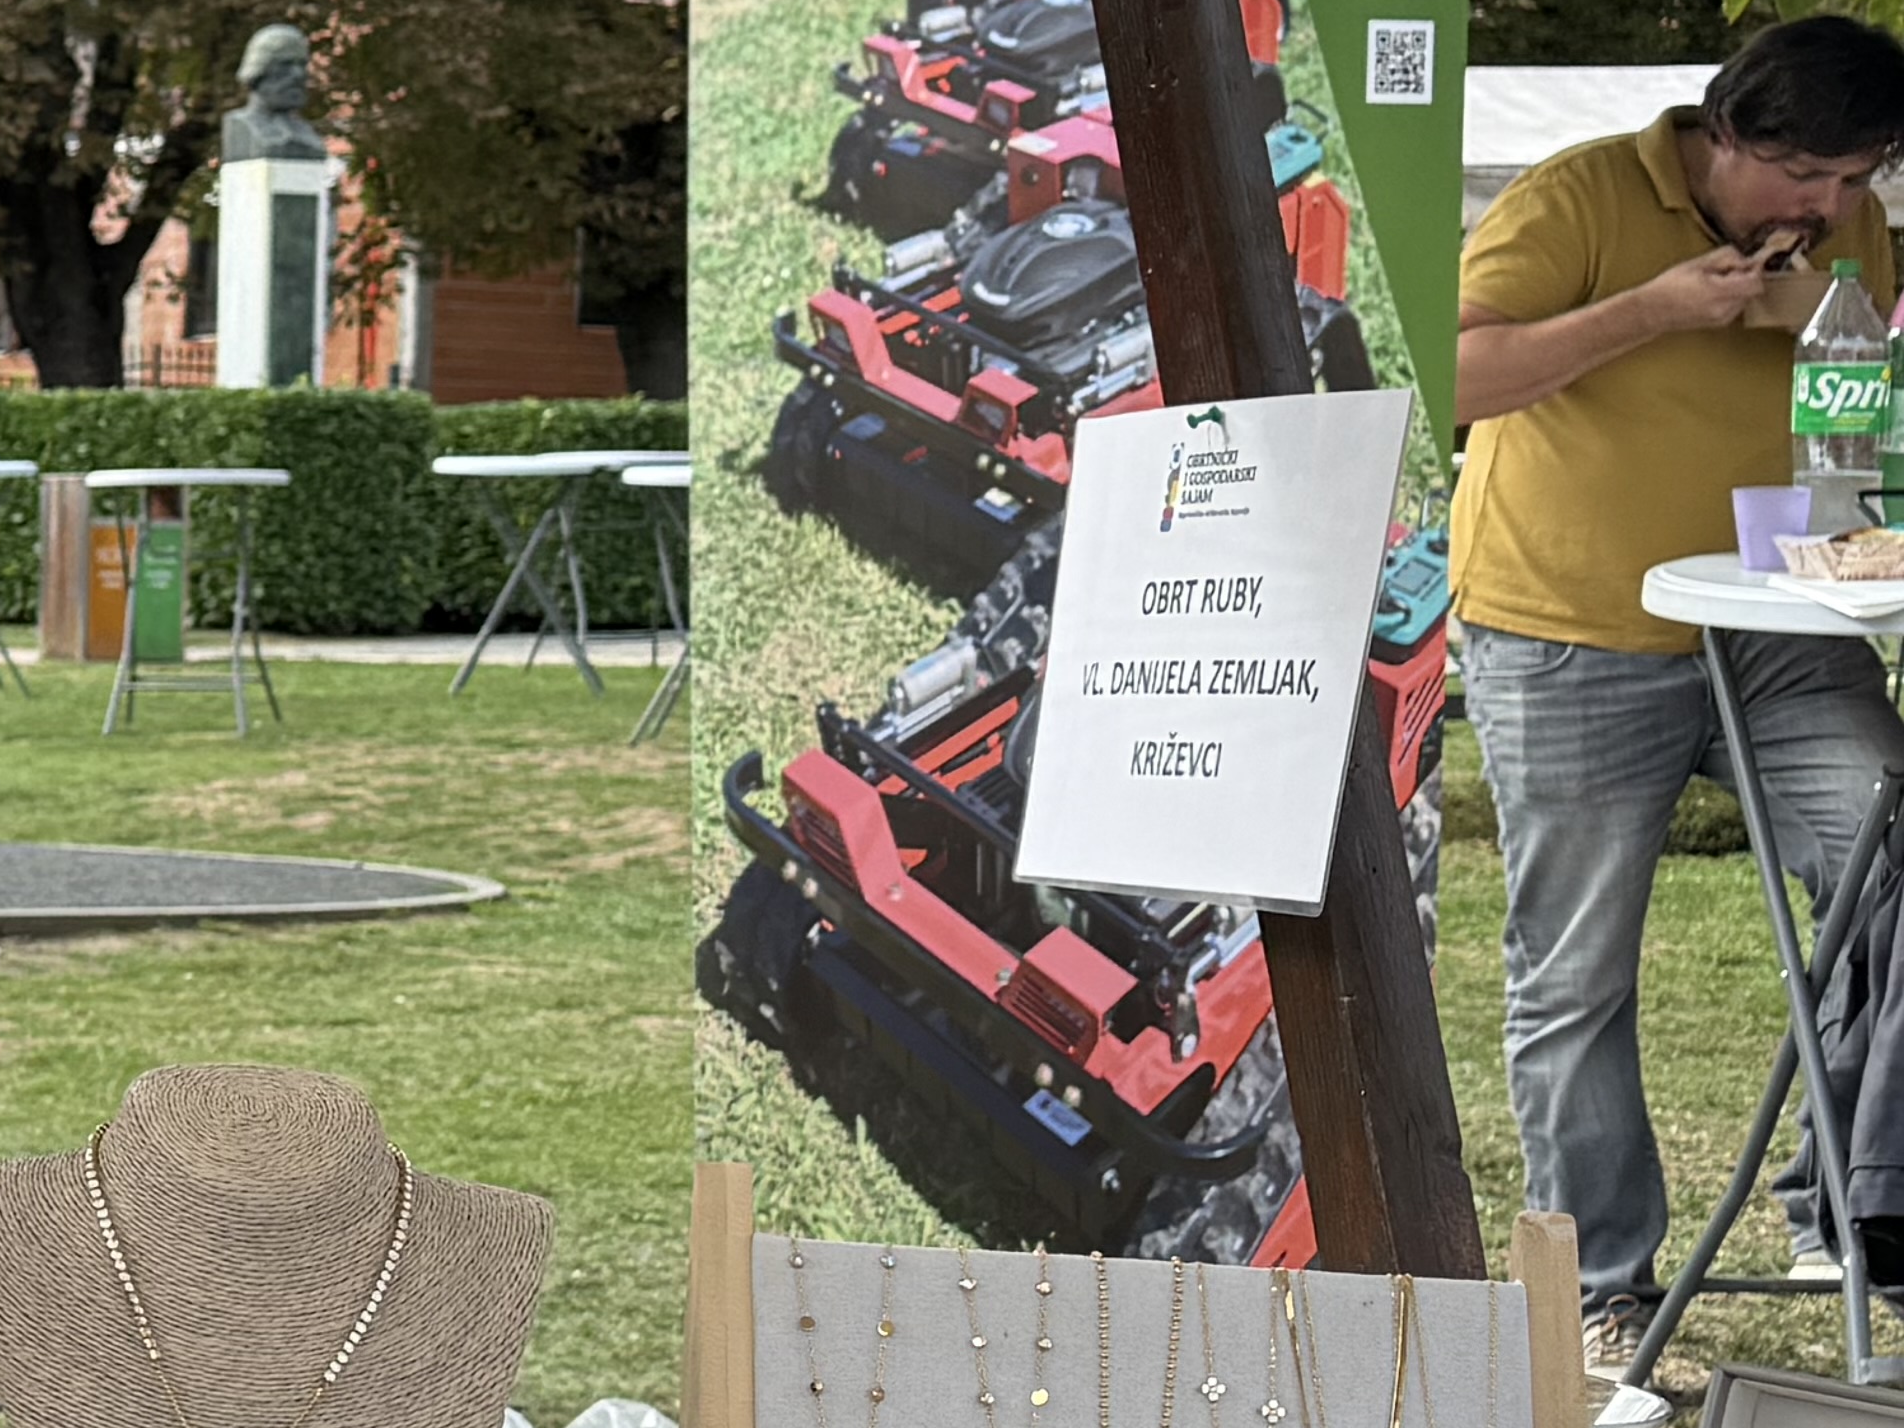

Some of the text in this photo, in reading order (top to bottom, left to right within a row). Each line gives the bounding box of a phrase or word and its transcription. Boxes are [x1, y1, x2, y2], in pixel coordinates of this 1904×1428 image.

[1141, 575, 1264, 618] OBRT RUBY,
[1082, 658, 1320, 703] VL. DANIJELA ZEMLJAK,
[1129, 732, 1223, 778] KRIŽEVCI
